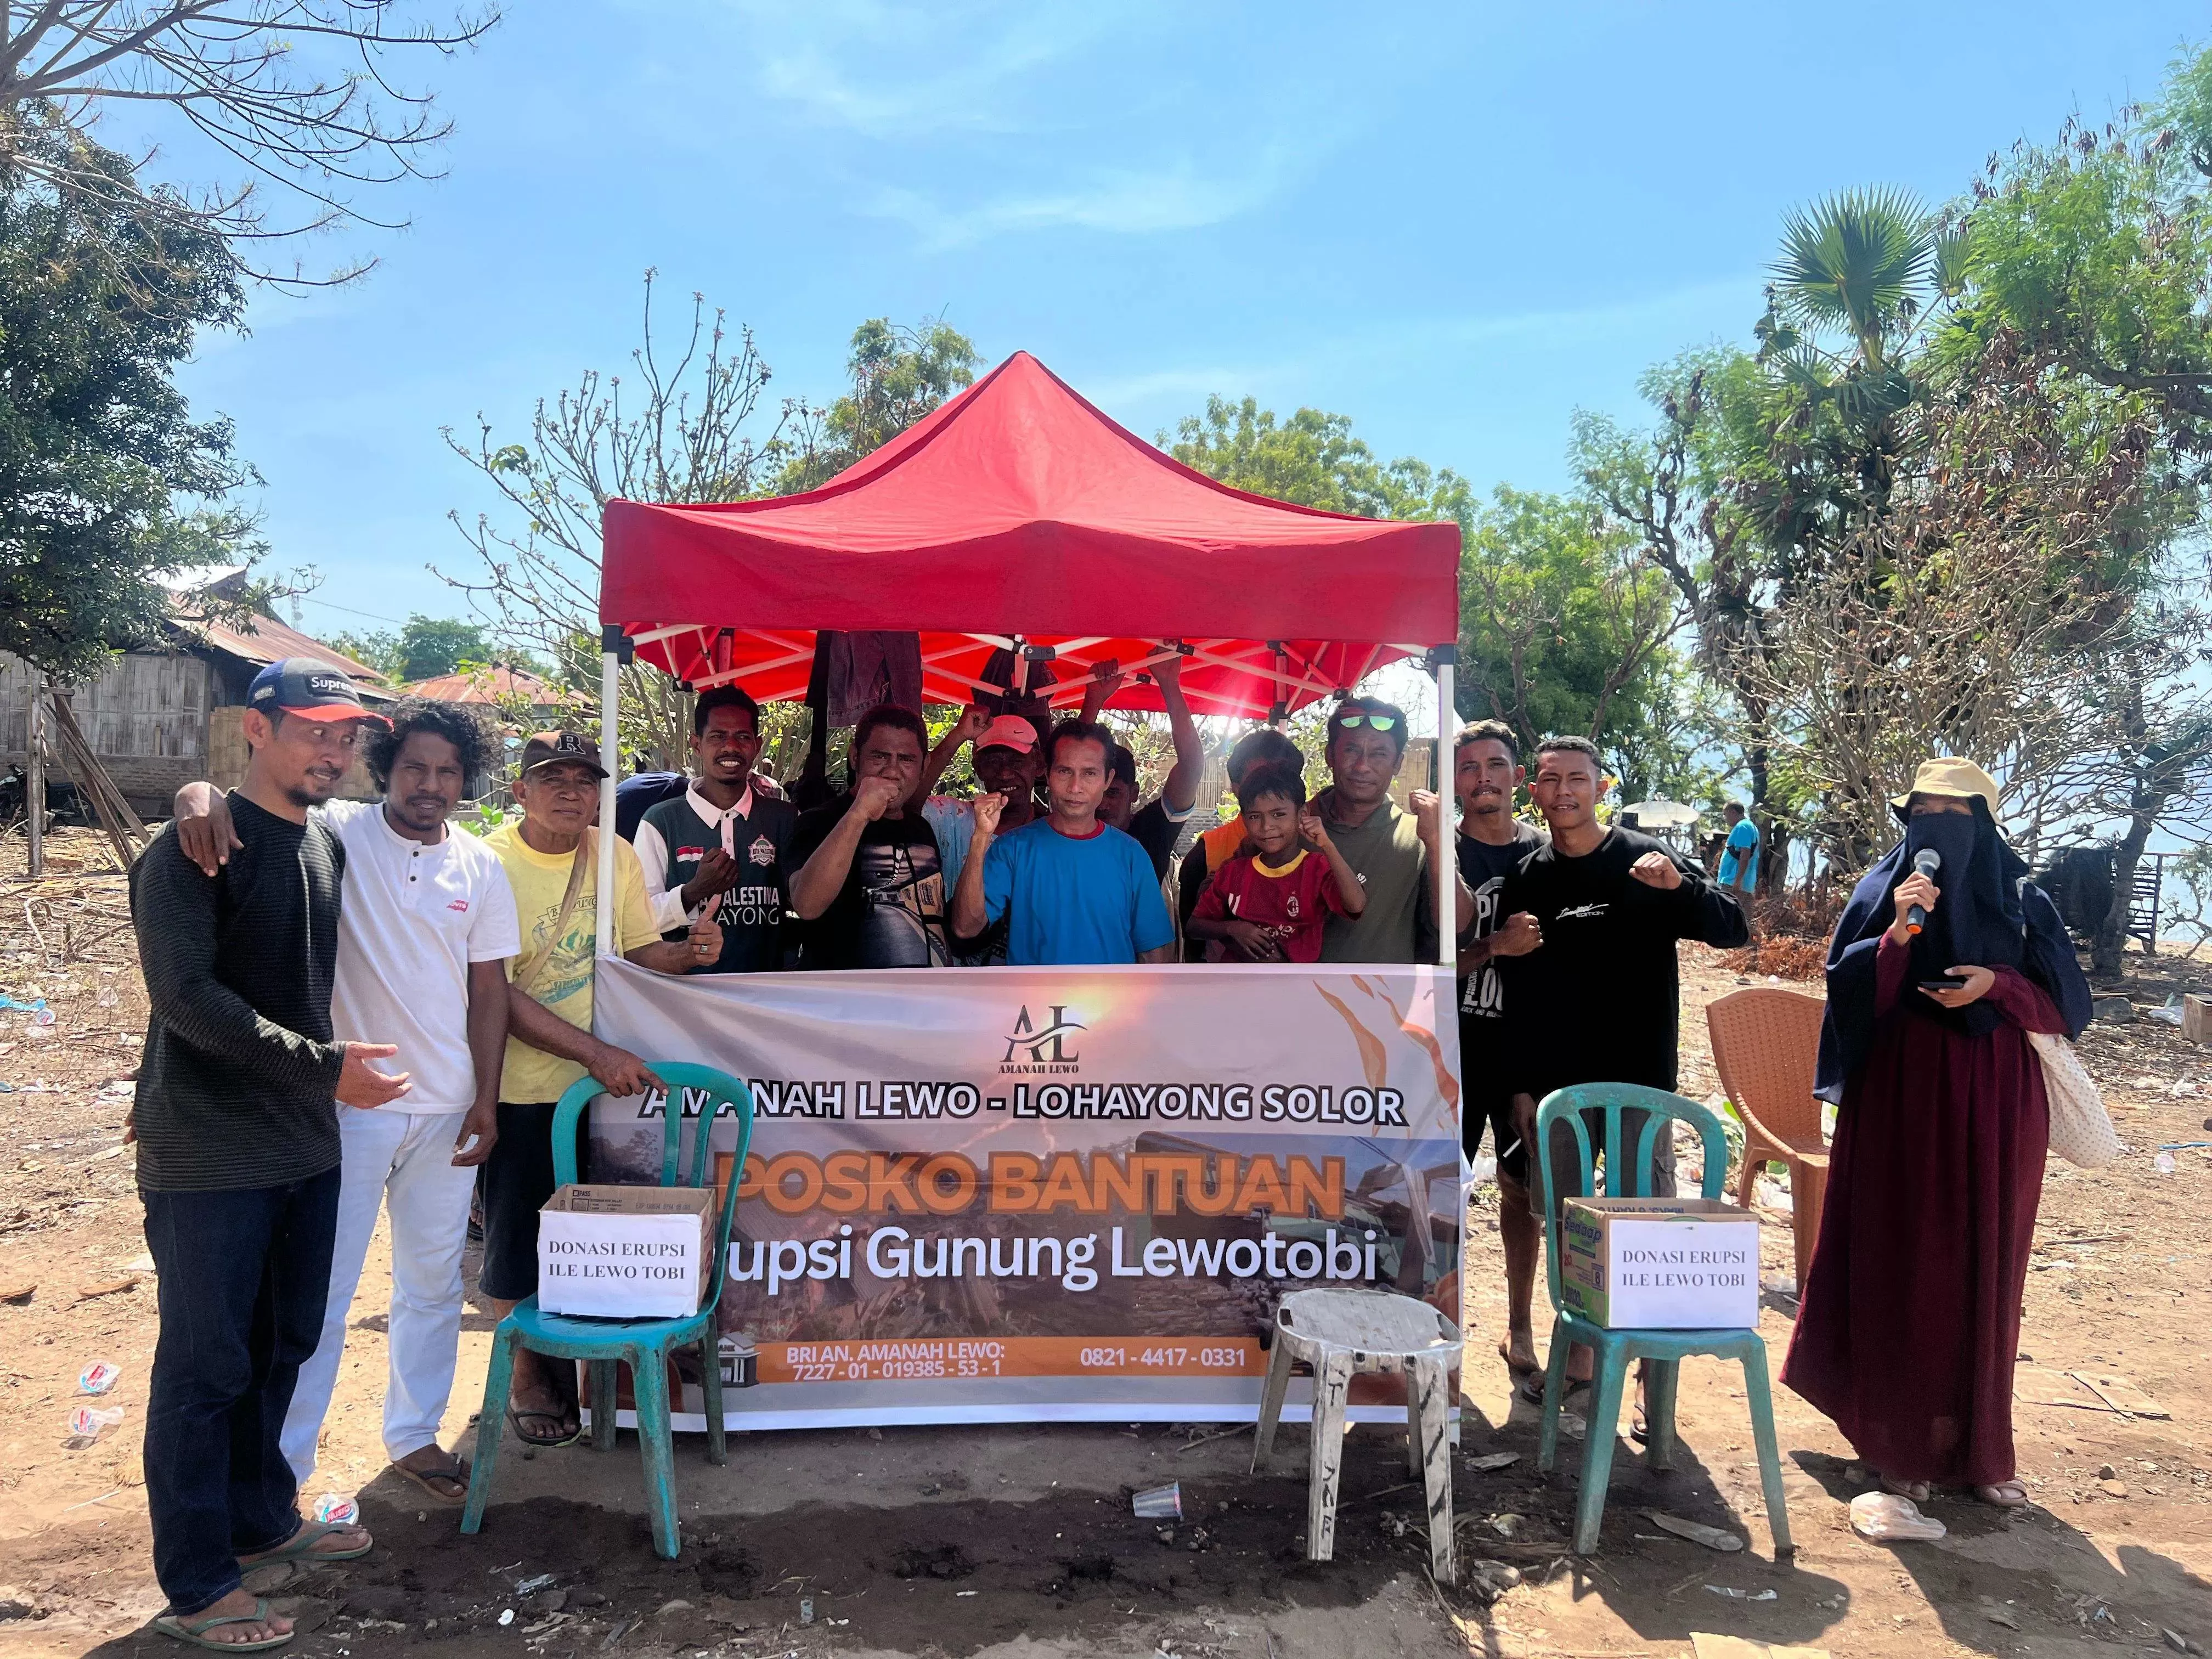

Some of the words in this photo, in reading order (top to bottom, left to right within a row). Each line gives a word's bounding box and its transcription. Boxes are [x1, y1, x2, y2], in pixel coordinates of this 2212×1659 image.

[557, 733, 586, 755] R
[722, 886, 780, 906] ALESTINA
[998, 1064, 1046, 1074] AMANAH
[1048, 1064, 1080, 1074] LEWO
[855, 1081, 980, 1119] LEWO
[987, 1098, 1006, 1110] -
[1014, 1084, 1253, 1120] LOHAYONG
[1260, 1085, 1410, 1127] SOLOR
[715, 1150, 978, 1216] POSKO
[988, 1152, 1346, 1219] BANTUAN
[549, 1240, 616, 1256] DONASI
[621, 1243, 686, 1257] ERUPSI
[1622, 1250, 1684, 1264] DONASI
[1689, 1250, 1746, 1264] ERUPSI
[727, 1224, 851, 1296] upsi
[866, 1226, 1098, 1292] Gunung
[1111, 1226, 1376, 1280] Lewotobi
[549, 1263, 578, 1277] ILE
[583, 1265, 637, 1279] LEWO
[641, 1266, 686, 1280] TOBI
[1622, 1273, 1650, 1286] ILE
[1655, 1273, 1703, 1286] LEWO
[1707, 1273, 1745, 1286] TOBI
[787, 1347, 816, 1363] BRI
[820, 1345, 854, 1362] AN.
[857, 1343, 943, 1361] AMANAH
[948, 1341, 1005, 1358] LEWO:
[1080, 1347, 1125, 1366] 0821
[1140, 1347, 1187, 1366] 4417
[1201, 1347, 1245, 1366] 0331
[793, 1363, 835, 1381] 7227
[848, 1363, 868, 1379] 01
[882, 1361, 945, 1378] 019385
[958, 1360, 978, 1376] 53
[992, 1359, 1001, 1375] 1
